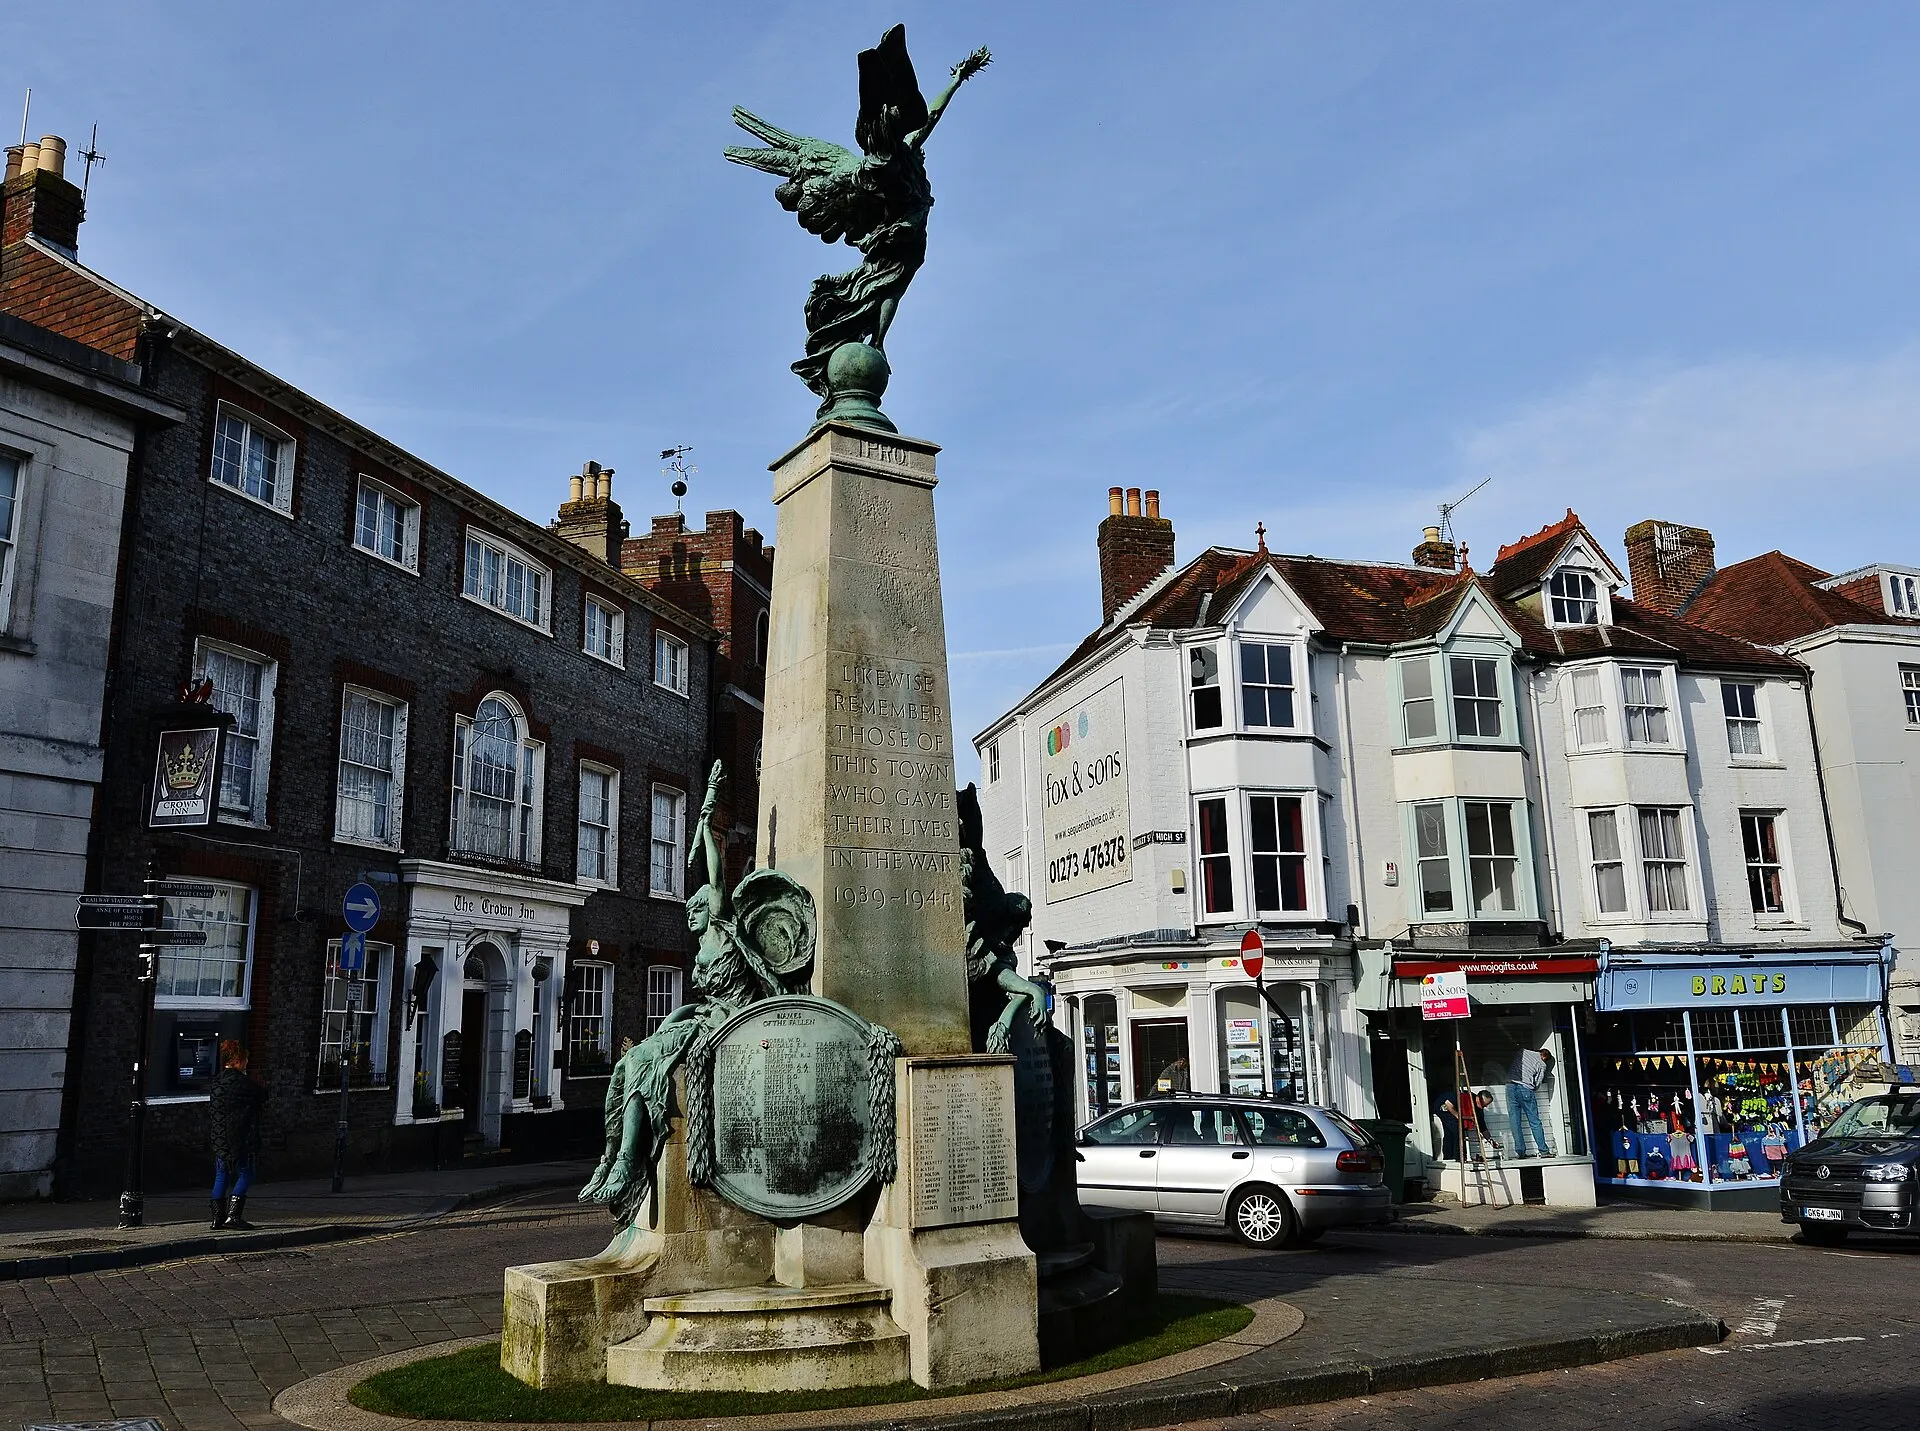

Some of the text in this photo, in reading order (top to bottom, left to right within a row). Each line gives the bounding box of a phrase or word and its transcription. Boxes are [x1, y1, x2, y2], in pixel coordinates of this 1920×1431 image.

[843, 665, 933, 693] LIKEWISE
[833, 694, 944, 722] REMEMBER
[835, 725, 944, 751] THOSE OF
[830, 755, 949, 781] THIS TOWN
[1046, 751, 1121, 808] fox & sons
[830, 784, 950, 809] WHO GAVE
[831, 814, 951, 838] THEIR LIVES
[1054, 807, 1116, 840] www.sequencehome.co.uk
[1156, 832, 1172, 841] HIGH
[830, 850, 952, 872] IN THE WAR
[1049, 835, 1125, 883] 01273 476378
[454, 895, 535, 920] The Crown Inn
[1274, 957, 1286, 965] fox
[1459, 962, 1538, 974] www.mojogifts.co.uk
[1421, 985, 1466, 997] fox & sons
[1691, 974, 1786, 996] BRATS
[1434, 1000, 1447, 1008] sale
